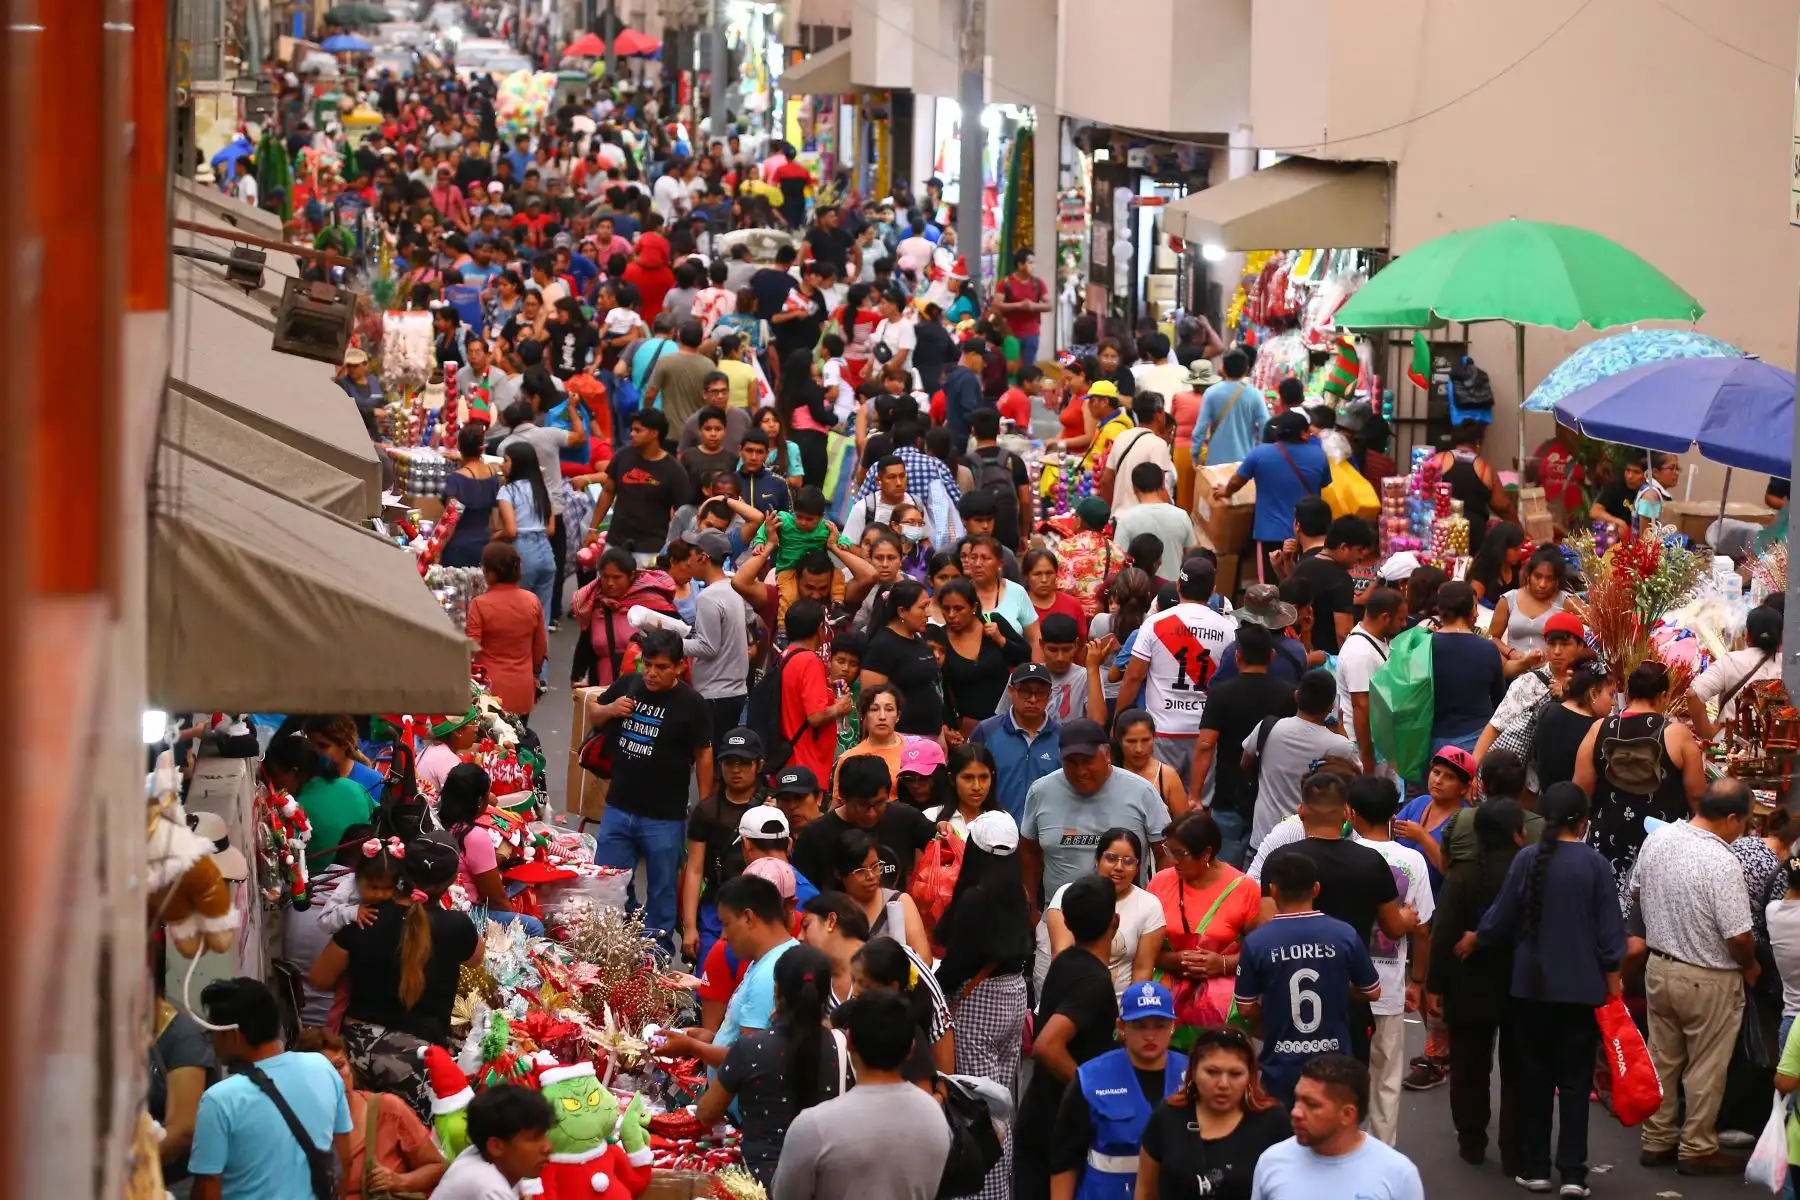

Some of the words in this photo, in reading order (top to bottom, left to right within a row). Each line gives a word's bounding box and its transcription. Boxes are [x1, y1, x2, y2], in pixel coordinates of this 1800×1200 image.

[1171, 626, 1224, 642] JONATHAN
[1172, 646, 1211, 692] 11
[627, 741, 653, 756] RIDING
[1271, 943, 1336, 963] FLORES
[1138, 996, 1162, 1007] LIMA
[1289, 968, 1322, 1034] 6
[1613, 1039, 1627, 1077] Wong
